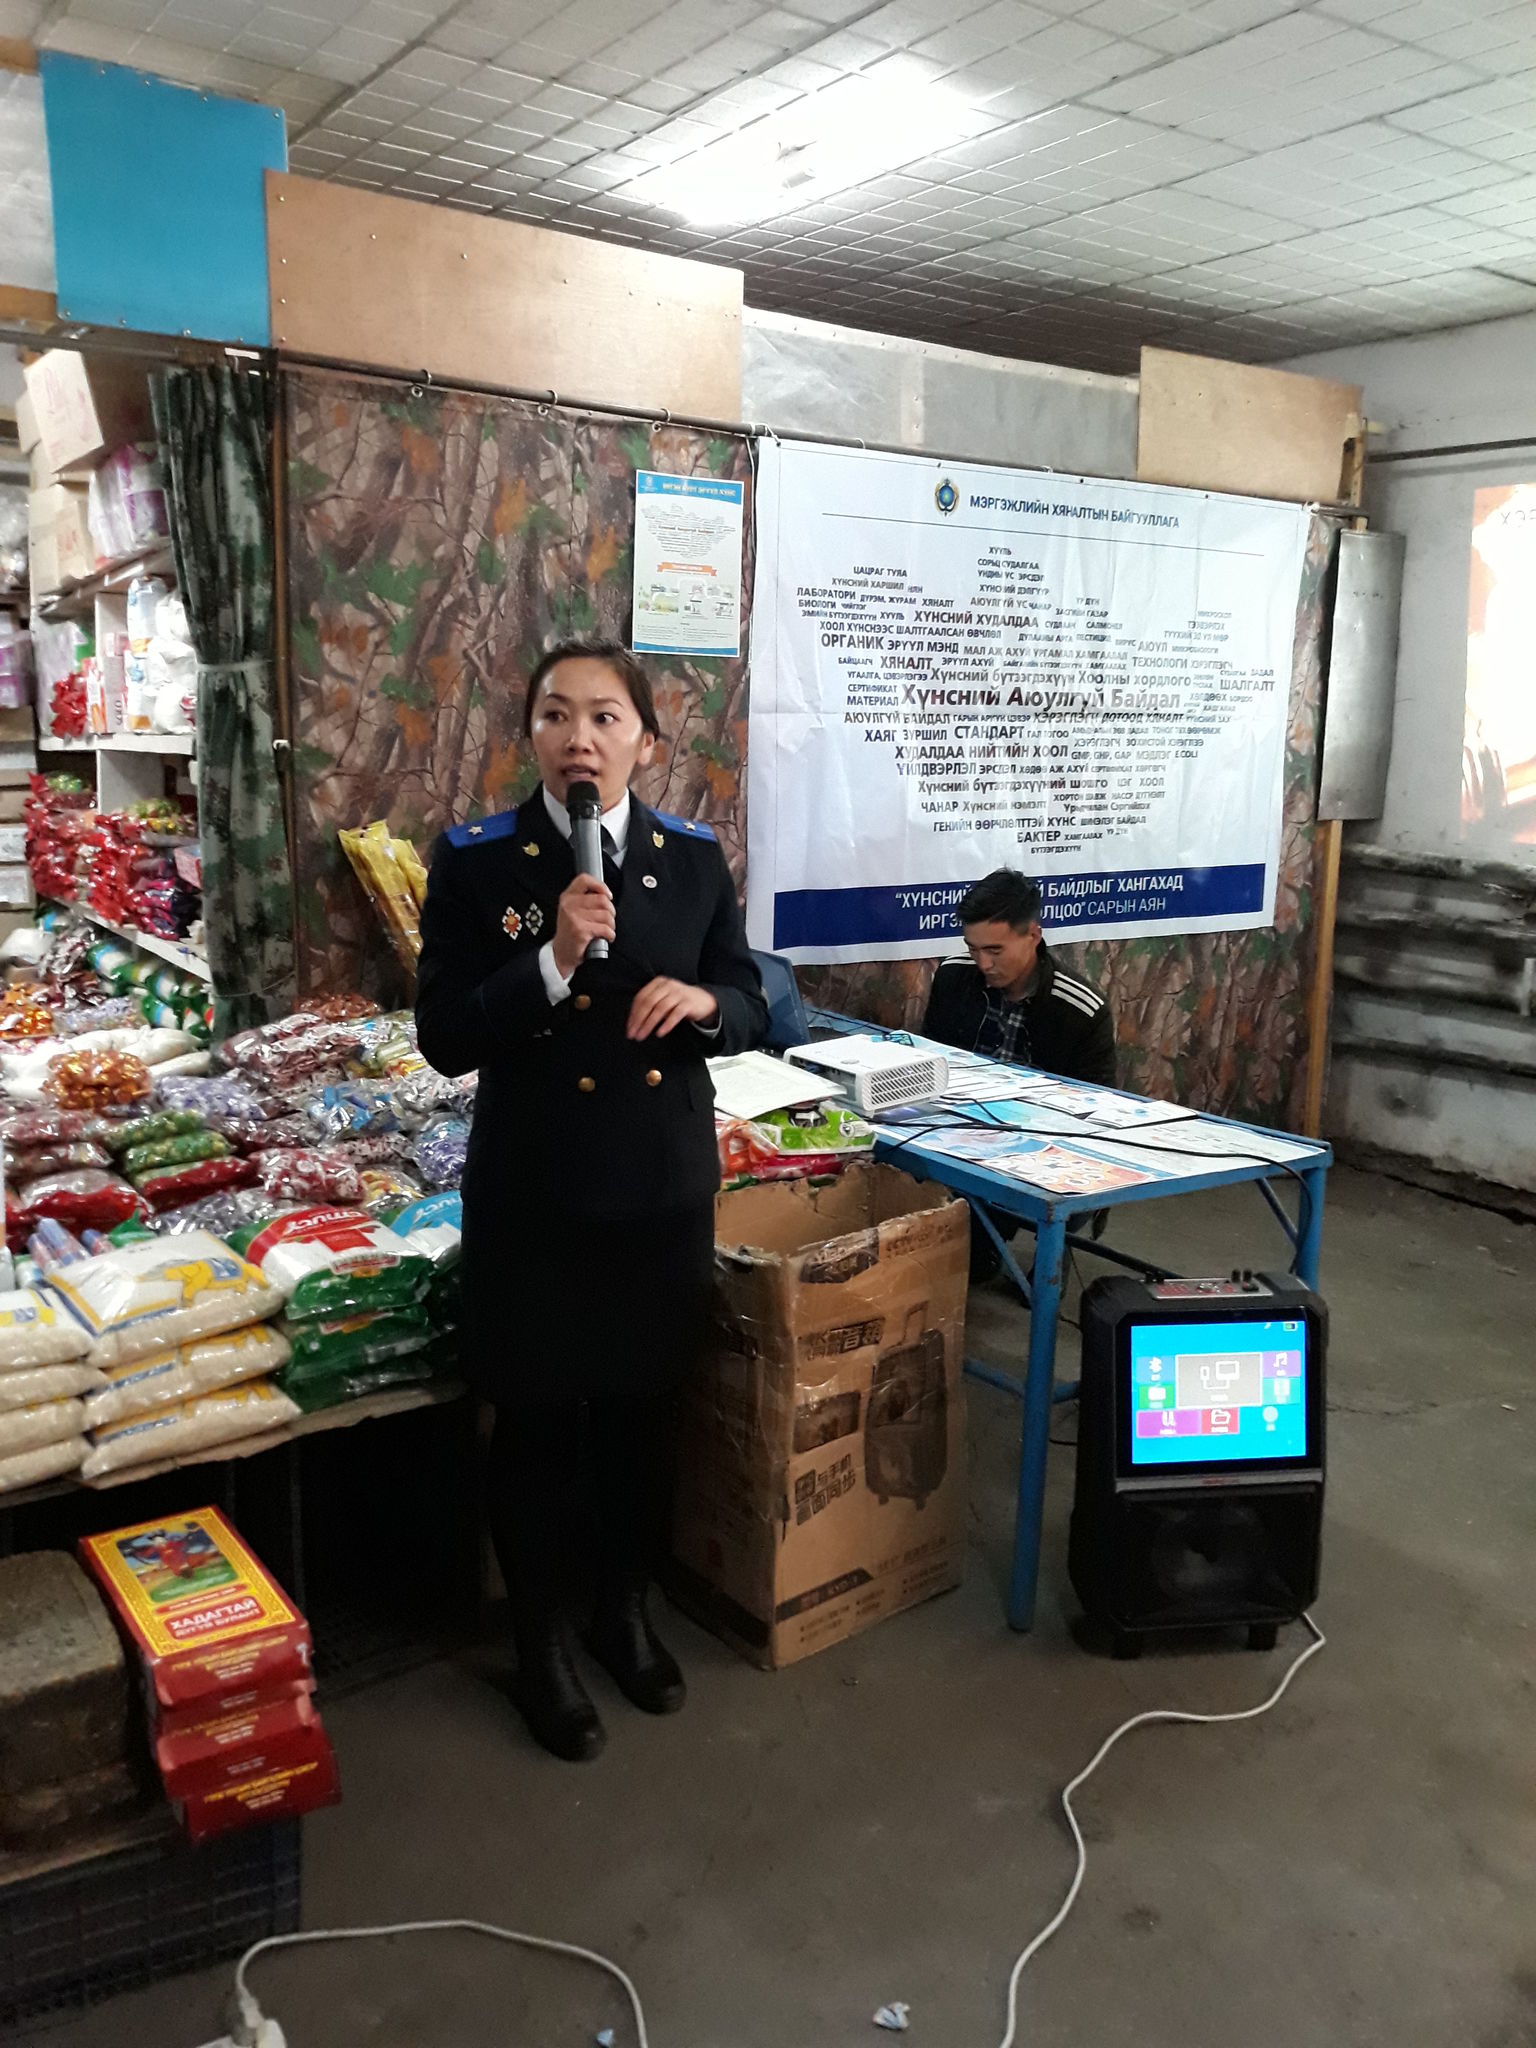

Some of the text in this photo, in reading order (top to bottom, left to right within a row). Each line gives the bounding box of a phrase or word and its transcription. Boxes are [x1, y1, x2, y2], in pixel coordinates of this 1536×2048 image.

[969, 495, 1180, 528] МЭРГЭЖЛИЙН ХЯНАЛТЫН БАЙГУУЛЛАГА
[853, 566, 908, 577] ЦАЦРАГ ТУЯА
[1002, 560, 1040, 570] СУДАЛГАА
[871, 581, 904, 590] ХАРШИЛ
[796, 587, 856, 600] ЛАБОРАТОРИ
[922, 598, 954, 607] ХЯНАЛТ
[798, 599, 837, 609] БИОЛОГИ
[914, 610, 973, 625] ХҮНСНИЙ
[976, 613, 1039, 628] ХУДАЛДАА
[819, 621, 845, 631] ХООЛ
[847, 622, 895, 634] ХҮНСНЭЭС
[896, 625, 965, 638] ШАЛТГААЛСАН
[966, 628, 1002, 639] ӨВЧЛӨЛ
[821, 633, 885, 650] ОРГАНИК
[887, 639, 924, 651] ЭРҮҮЛ
[927, 641, 960, 655] МЭНД
[963, 645, 986, 655] МАЛ
[1137, 641, 1168, 653] АЮУЛ
[880, 656, 934, 670] ХЯНАЛТ
[941, 657, 969, 667] ЭРҮҮЛ
[1132, 656, 1188, 669] ТЕХНОЛОГИ
[930, 667, 989, 684] Хүнсний
[992, 668, 1075, 687] бүтээгдэхүүн
[1078, 670, 1130, 685] Хоолны
[1134, 674, 1192, 688] хордлого
[847, 683, 897, 693] СЕРТИФИКАТ
[1219, 679, 1275, 692] ШАЛГАЛТ
[846, 695, 899, 706] МАТЕРИАЛ
[901, 684, 1000, 711] Хүнсний
[1006, 686, 1105, 712] Аюулгүй
[1111, 688, 1180, 711] Байдал
[844, 711, 901, 724] АЮУЛГҮЙ
[903, 712, 950, 726] БАЙДАЛ
[864, 729, 897, 742] ХАЯГ
[954, 725, 1025, 741] СТАНДАРТ
[895, 742, 1069, 760] ХУДАЛДАА НИЙТИЙН ХООЛ
[896, 762, 976, 777] ҮЙЛДВЭРЛЭЛ
[979, 764, 1016, 775] ЭРСДЭЛ
[918, 780, 970, 796] Хүнсний
[973, 777, 1066, 795] бүтээгдэхүүний
[1139, 777, 1165, 787] ХООЛ
[921, 801, 959, 813] ЧАНАР
[962, 800, 1008, 814] Хүнсний
[933, 819, 972, 832] ГЕНИЙН
[975, 816, 1044, 831] ӨӨРЧЛӨЛТТЭЙ
[1047, 816, 1077, 827] ХҮНС
[1017, 830, 1061, 843] БАКТЕР
[1048, 879, 1114, 898] БАЙДЛЫГ
[1117, 875, 1184, 893] ХАНГАХАД
[1088, 898, 1136, 915] САРЫН
[1139, 896, 1166, 912] АЯН
[170, 1597, 258, 1630] ХАДАГТАЙ
